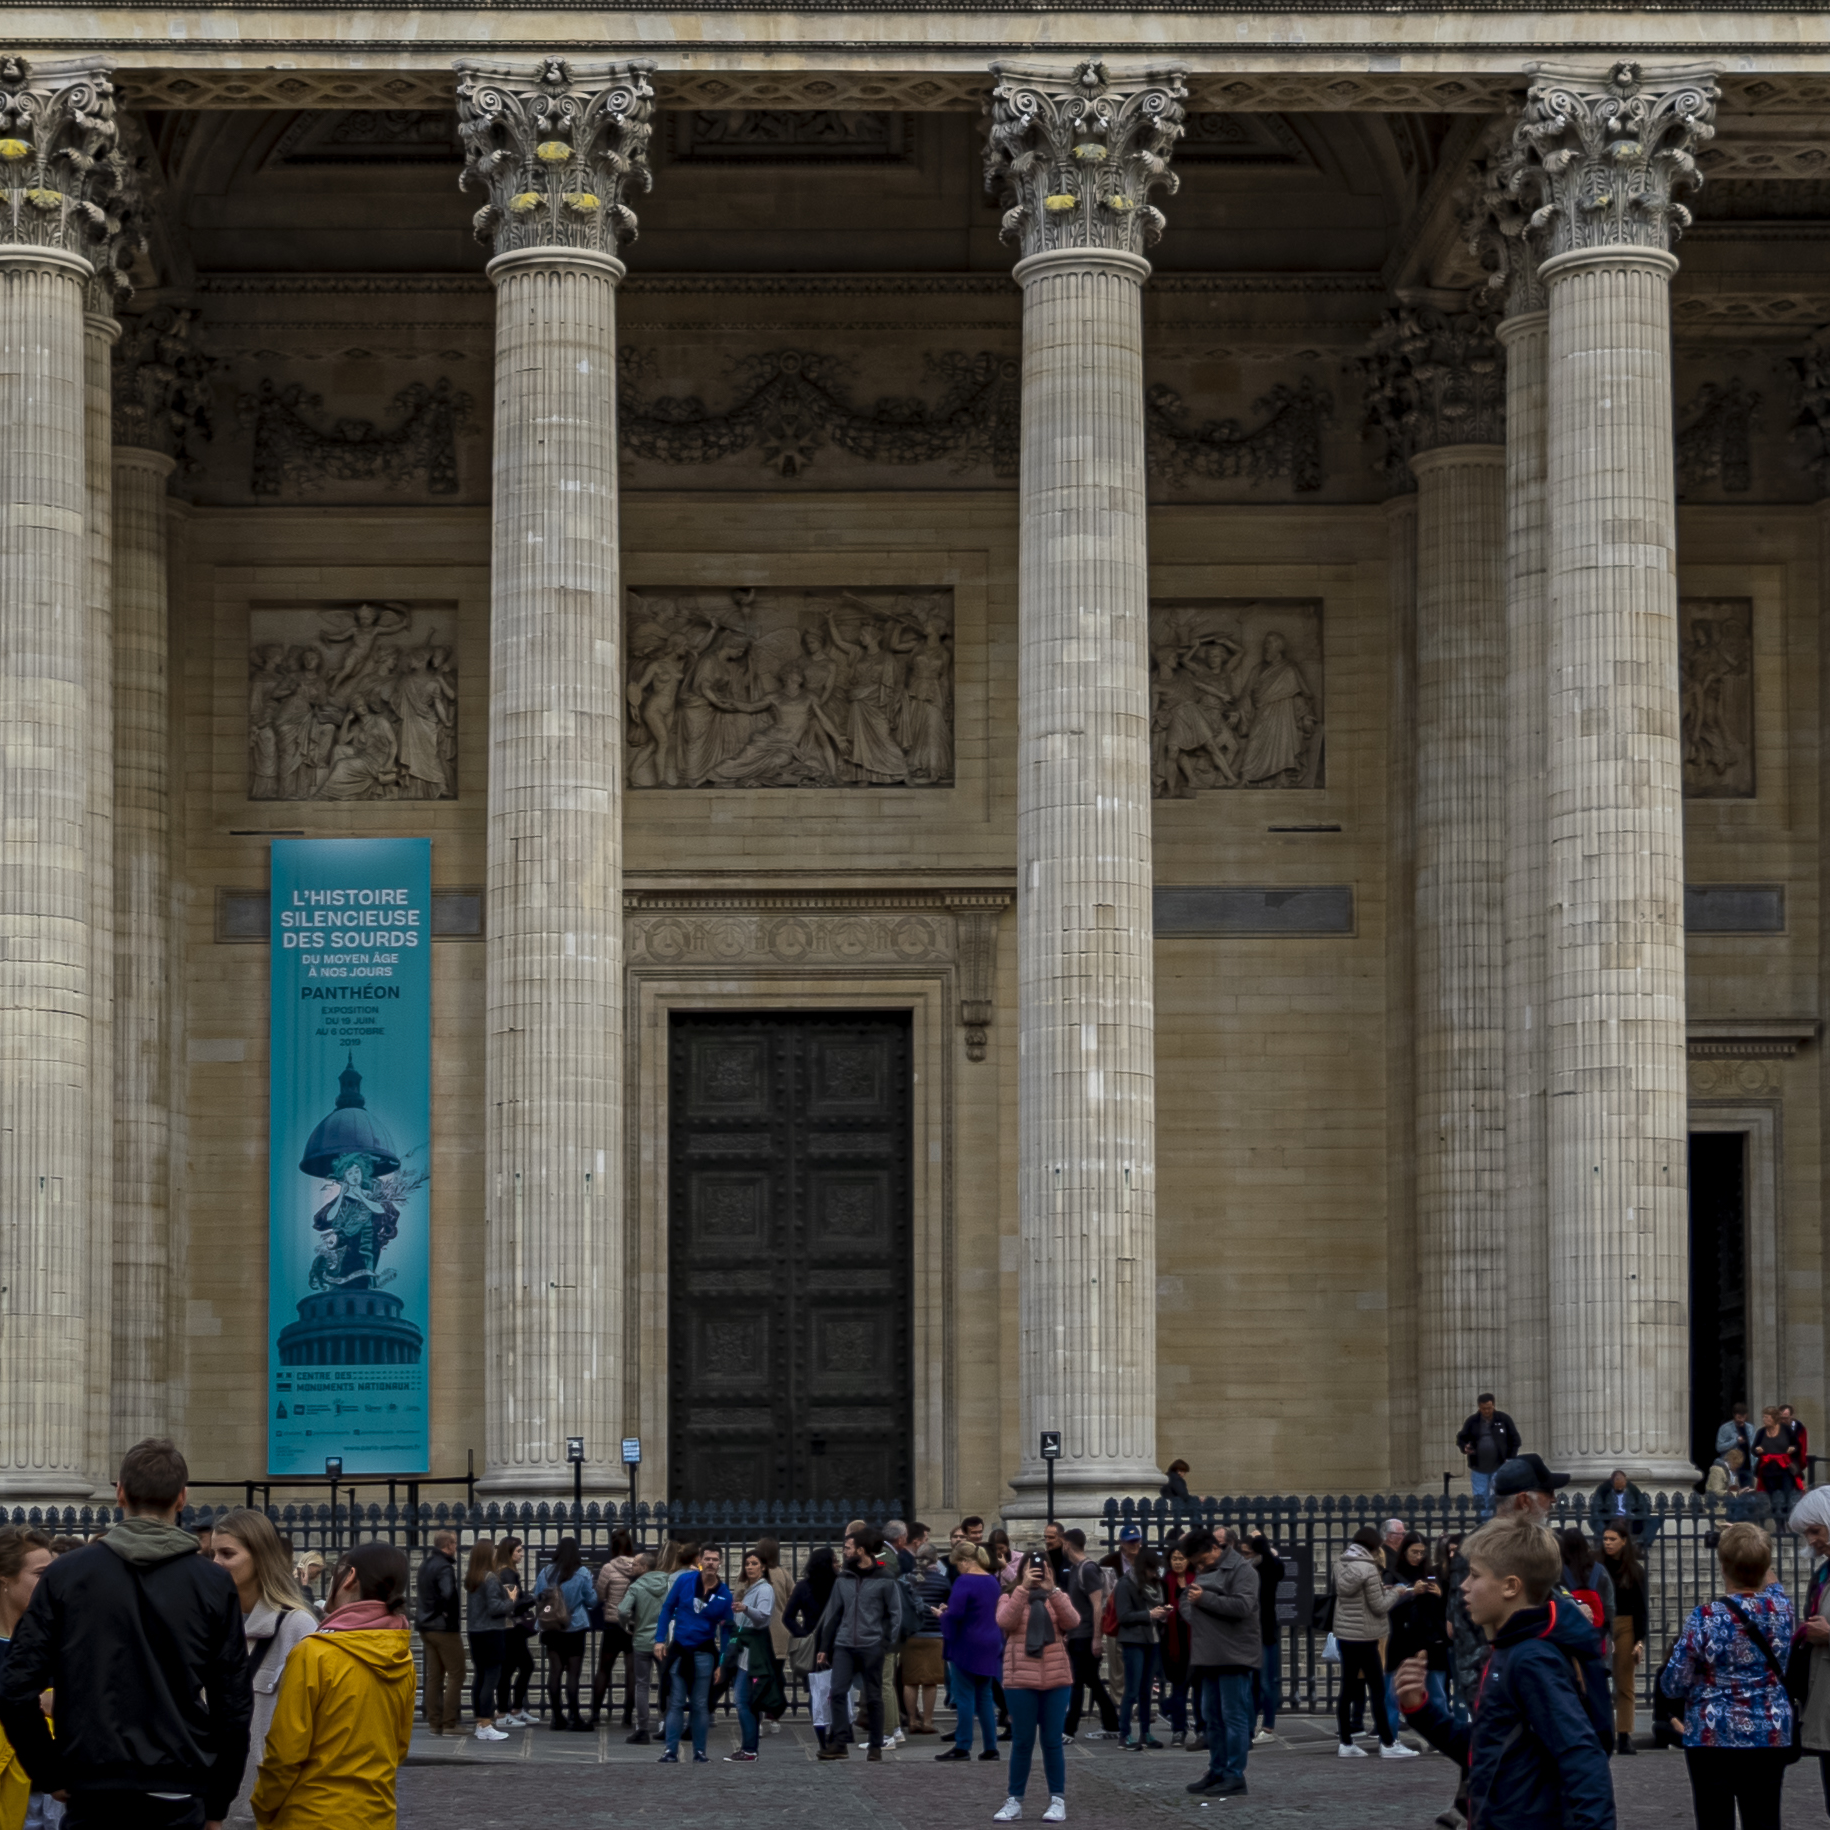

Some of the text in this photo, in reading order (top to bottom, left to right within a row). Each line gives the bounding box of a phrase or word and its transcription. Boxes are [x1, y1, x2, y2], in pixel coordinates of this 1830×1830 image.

[293, 889, 408, 906] L'HISTOIRE
[281, 910, 420, 927] SILENCIEUSE
[283, 931, 418, 948] DES SOURDS
[302, 951, 399, 964] DU MOYEN ÂGE
[308, 965, 392, 977] À NOS JOURS
[301, 982, 400, 1000] PANTHÉON
[321, 1006, 379, 1014] EXPOSITION
[325, 1017, 375, 1025] DU 19 JUIN
[315, 1027, 385, 1036] AU 6 OCTOBRE
[339, 1038, 361, 1046] 2019
[296, 1371, 352, 1380] CENTRE DES
[296, 1381, 410, 1391] MONUMENTS NATIONAUX
